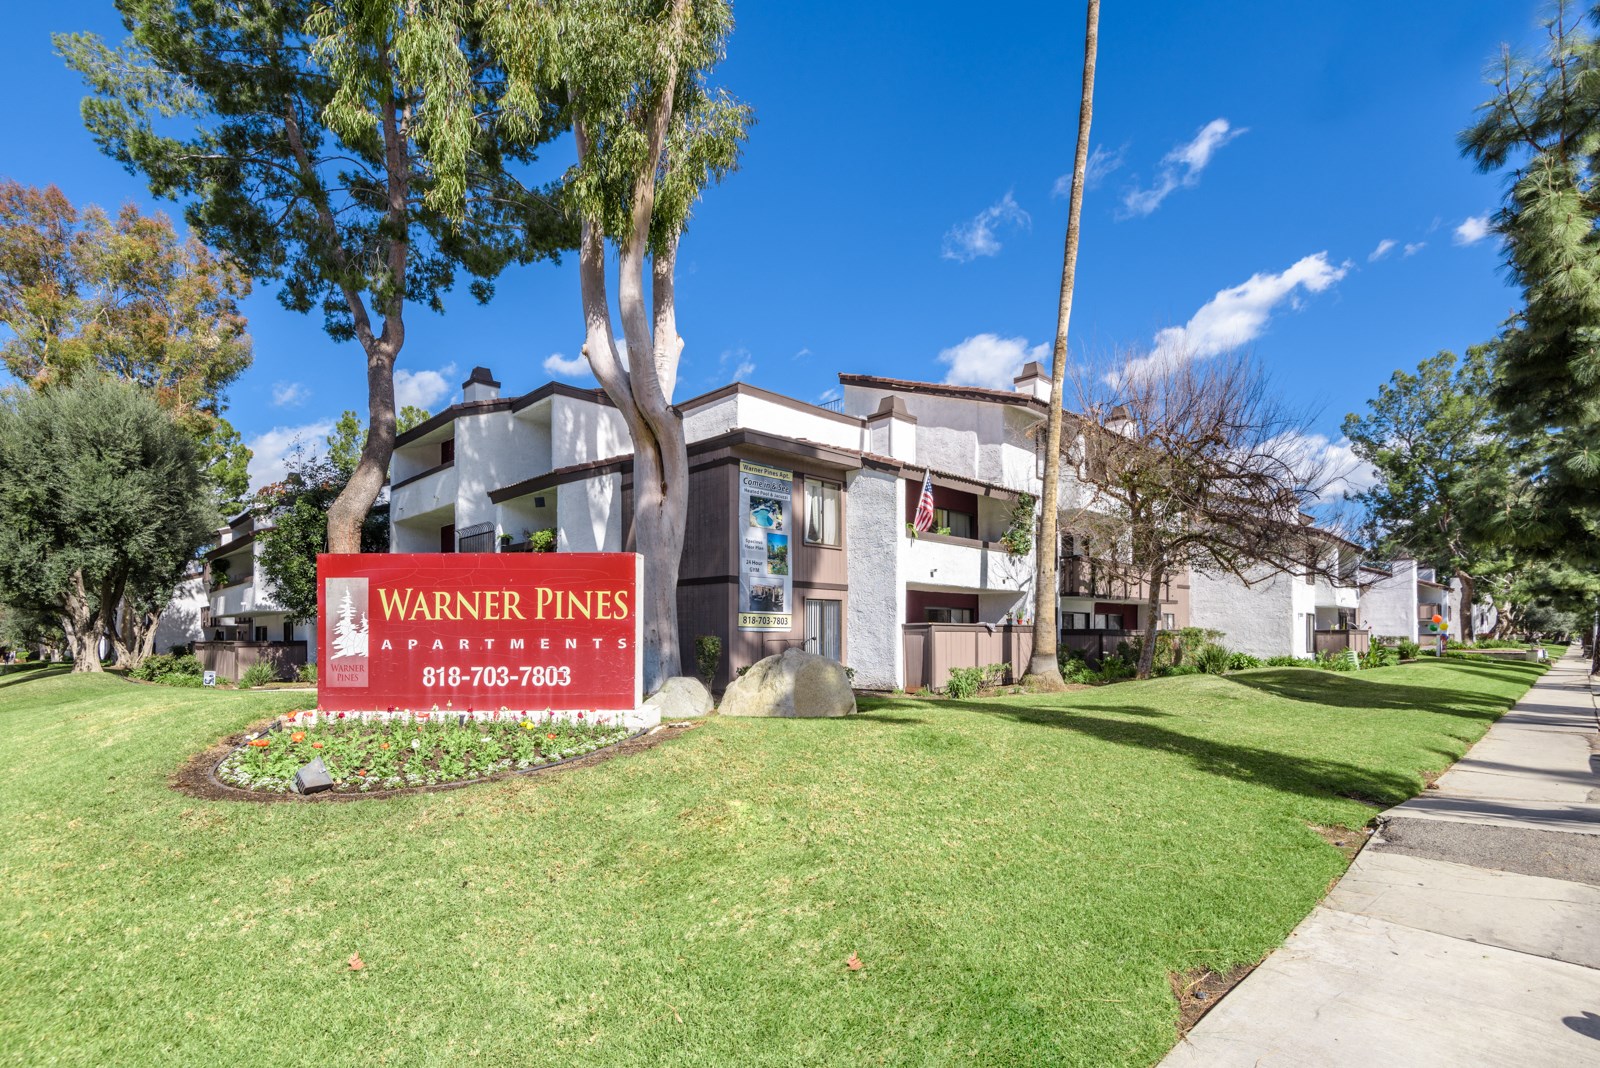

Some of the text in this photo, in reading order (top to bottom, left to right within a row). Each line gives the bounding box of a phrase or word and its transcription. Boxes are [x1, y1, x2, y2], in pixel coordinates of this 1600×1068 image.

[743, 464, 763, 473] Warner
[744, 477, 762, 487] Come
[764, 480, 770, 488] in
[778, 484, 789, 493] See
[377, 588, 628, 621] WARNER PINES
[742, 616, 788, 625] 818-703-7803
[381, 638, 627, 650] APARTMENTS
[331, 664, 364, 672] WARNER
[422, 666, 572, 687] 818-703-7803
